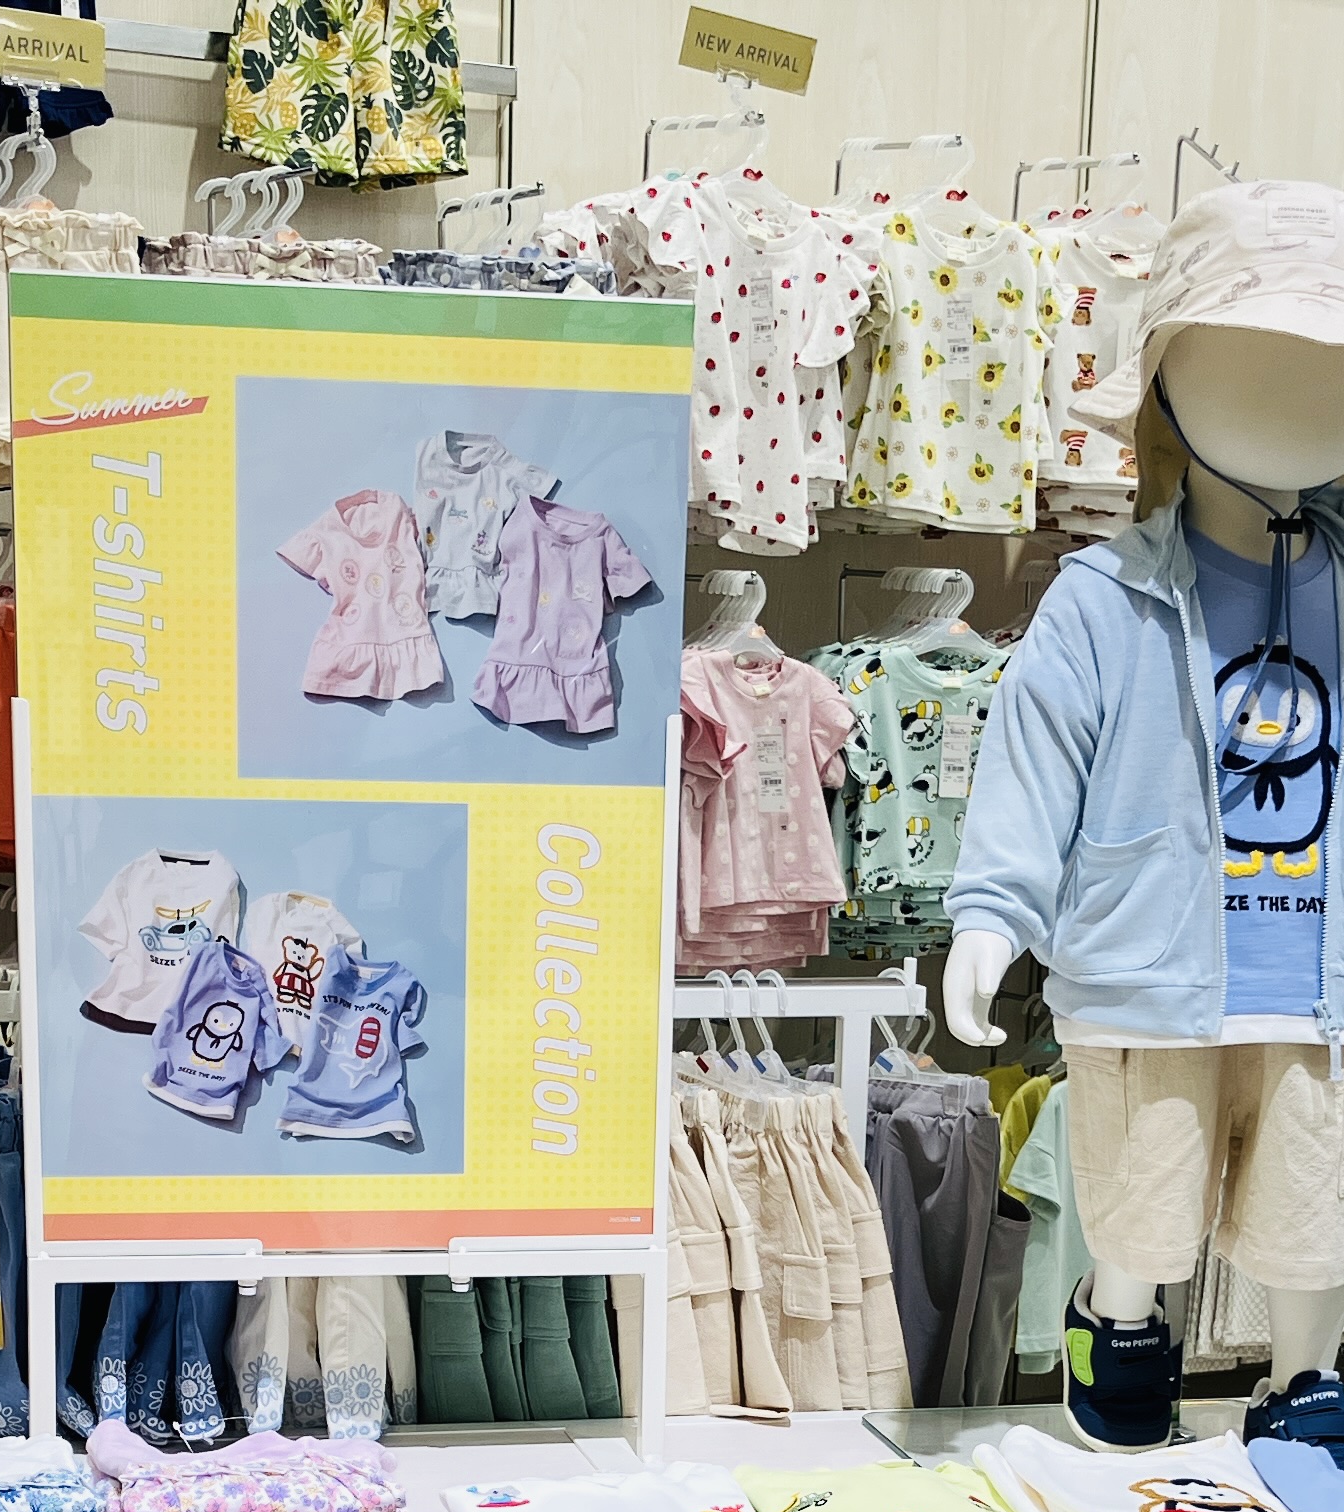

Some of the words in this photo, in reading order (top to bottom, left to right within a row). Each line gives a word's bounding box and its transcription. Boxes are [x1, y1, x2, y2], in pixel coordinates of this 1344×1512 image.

[3, 35, 90, 63] ARRIVAL
[694, 31, 731, 54] NEW
[735, 43, 799, 73] ARRIVAL
[31, 371, 194, 426] Summer
[92, 451, 164, 735] T-shirts
[1257, 895, 1290, 912] THE
[531, 822, 602, 1156] Collection
